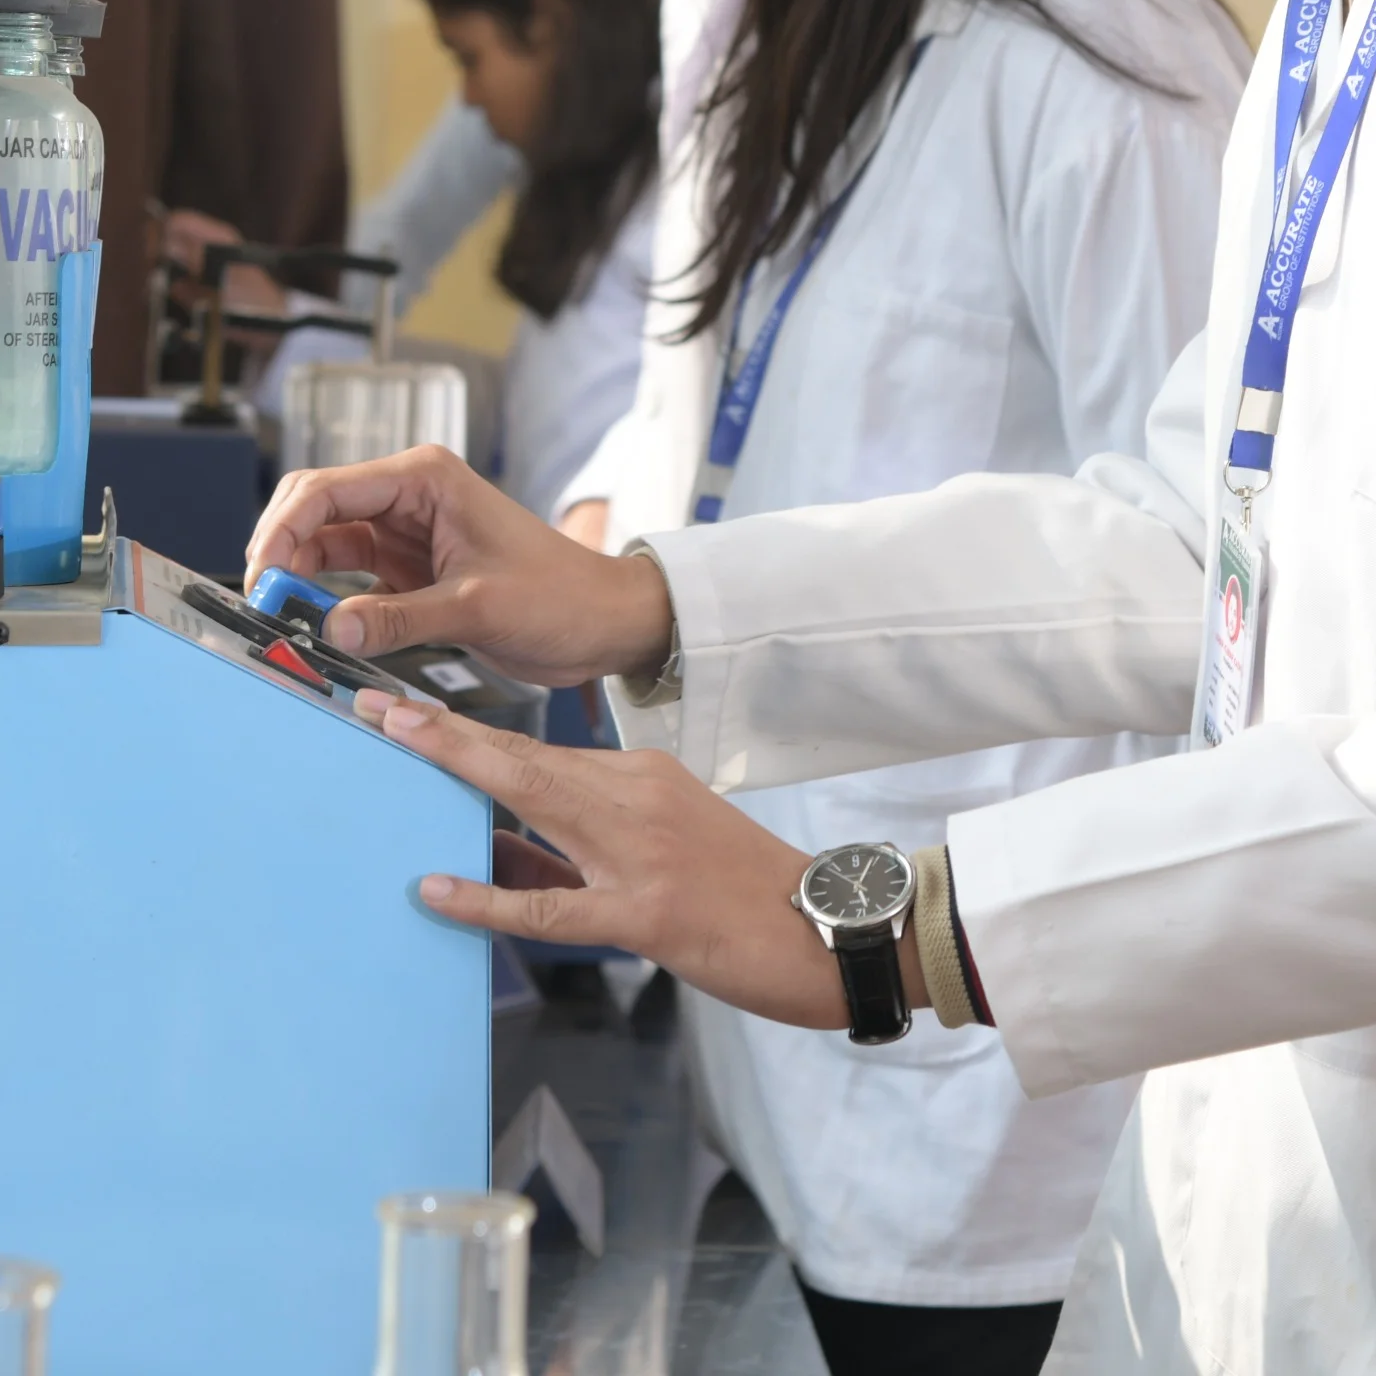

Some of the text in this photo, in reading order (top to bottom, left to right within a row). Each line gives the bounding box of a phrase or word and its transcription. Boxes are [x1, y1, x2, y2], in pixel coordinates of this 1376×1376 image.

[1309, 17, 1324, 54] GROUP
[1318, 3, 1330, 16] OF
[0, 137, 34, 158] JAR
[1295, 181, 1325, 256] INSTITUTIONS
[1266, 175, 1318, 307] ACCURATE
[1290, 254, 1302, 271] OF
[1278, 270, 1295, 311] GROUP
[25, 312, 49, 326] JAR
[4, 332, 22, 347] OF
